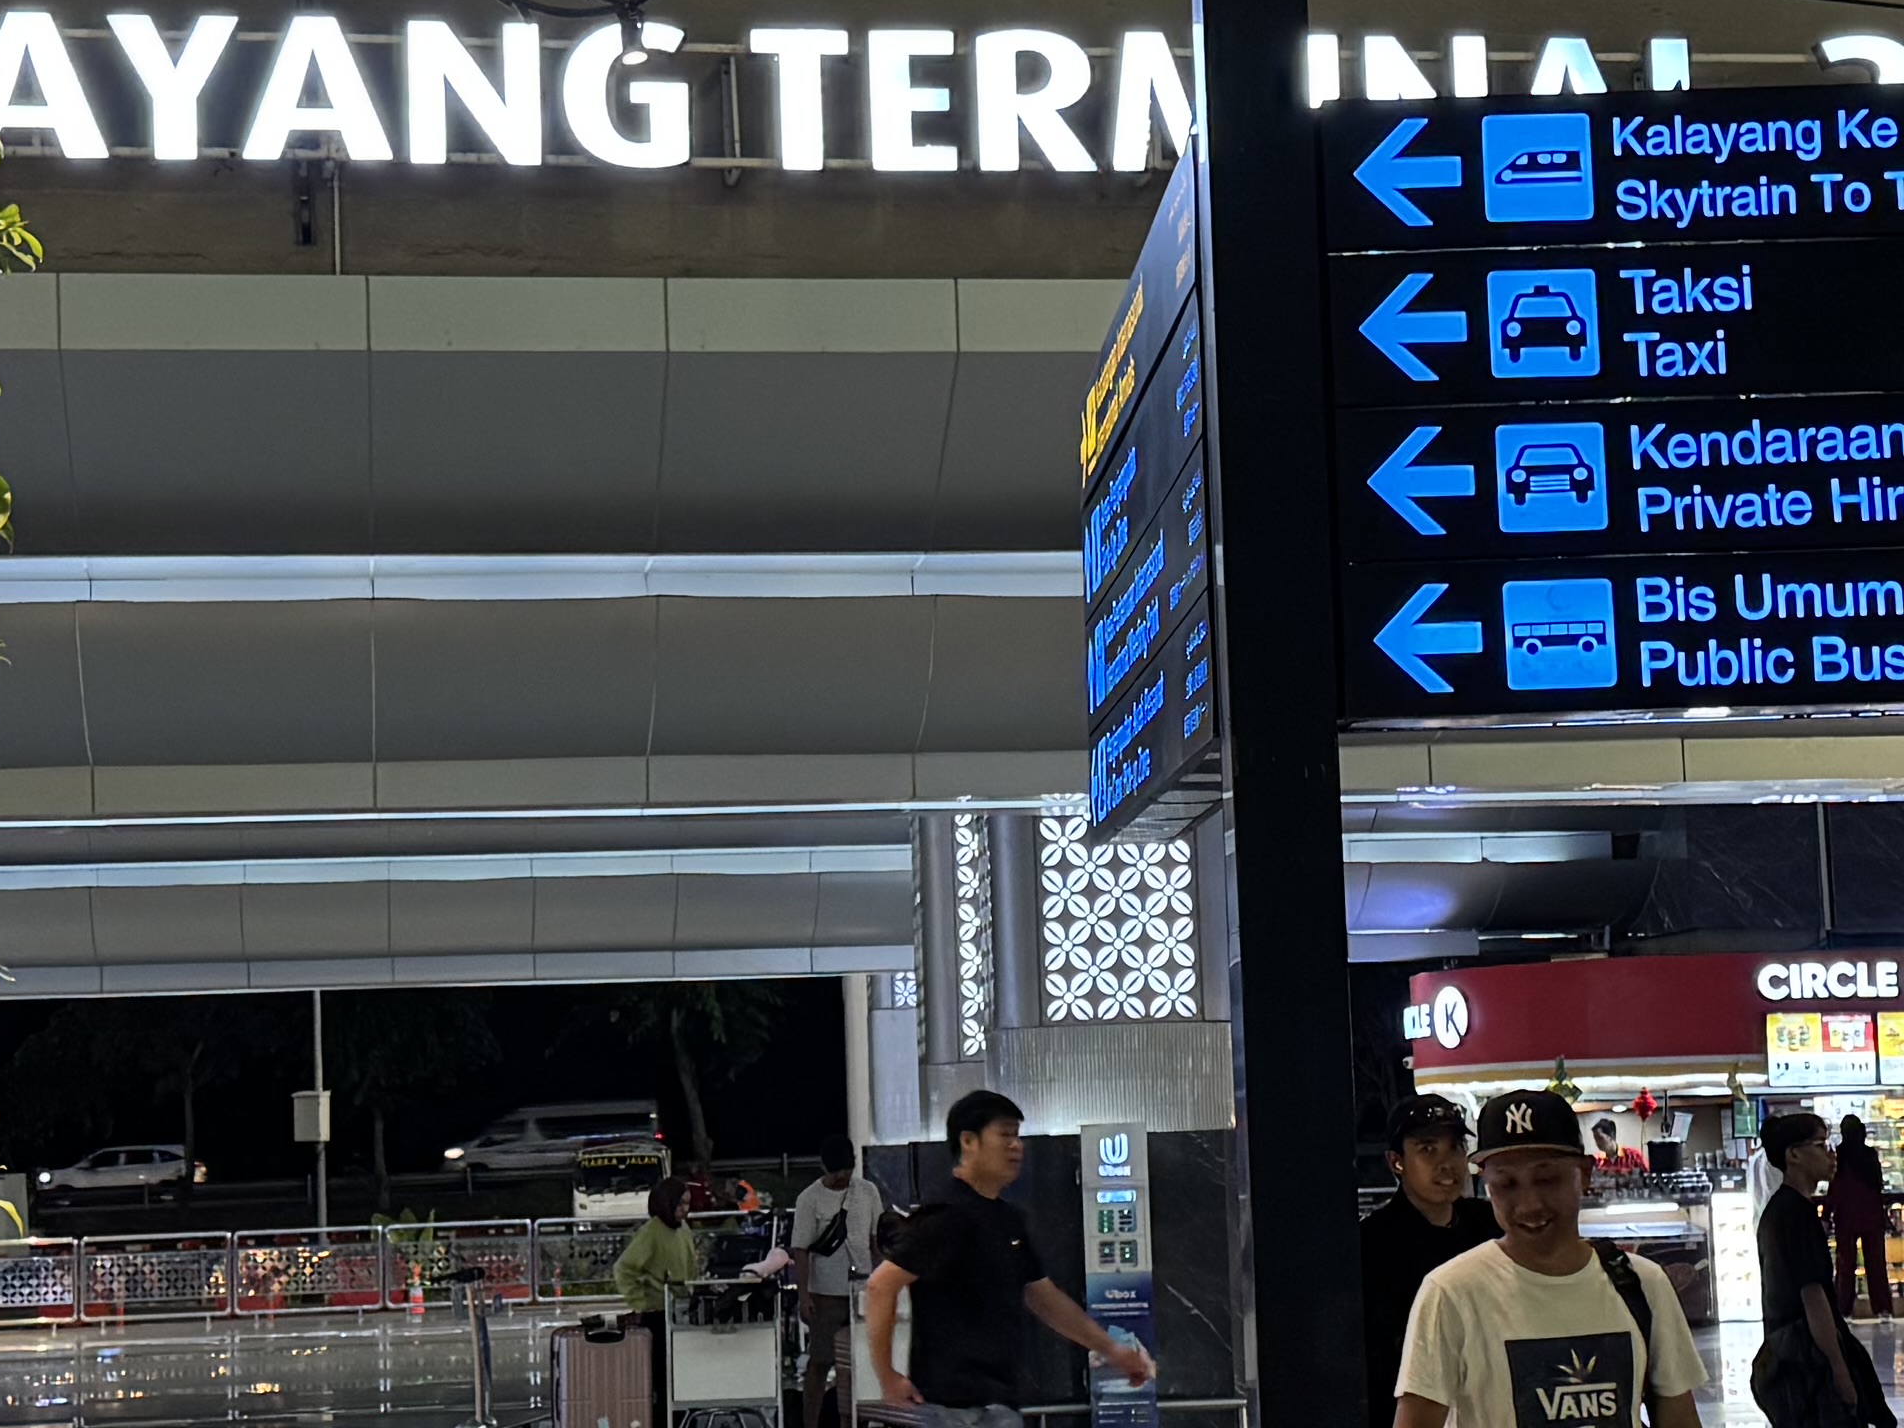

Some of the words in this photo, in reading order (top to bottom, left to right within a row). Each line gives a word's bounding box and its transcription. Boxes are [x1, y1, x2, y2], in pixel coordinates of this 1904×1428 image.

[1612, 114, 1822, 164] Kalayang
[1837, 108, 1898, 149] Ke
[1615, 175, 1796, 228] Skytrain
[1809, 172, 1871, 213] To
[1618, 264, 1752, 314] Taksi
[1622, 328, 1726, 377] Taxi
[1637, 483, 1812, 532] Private
[1635, 575, 1717, 622] Bis
[1734, 572, 1904, 620] Umum
[1639, 637, 1795, 687] Public
[1757, 960, 1900, 1001] CIRCLE
[1535, 1382, 1617, 1421] VANS
